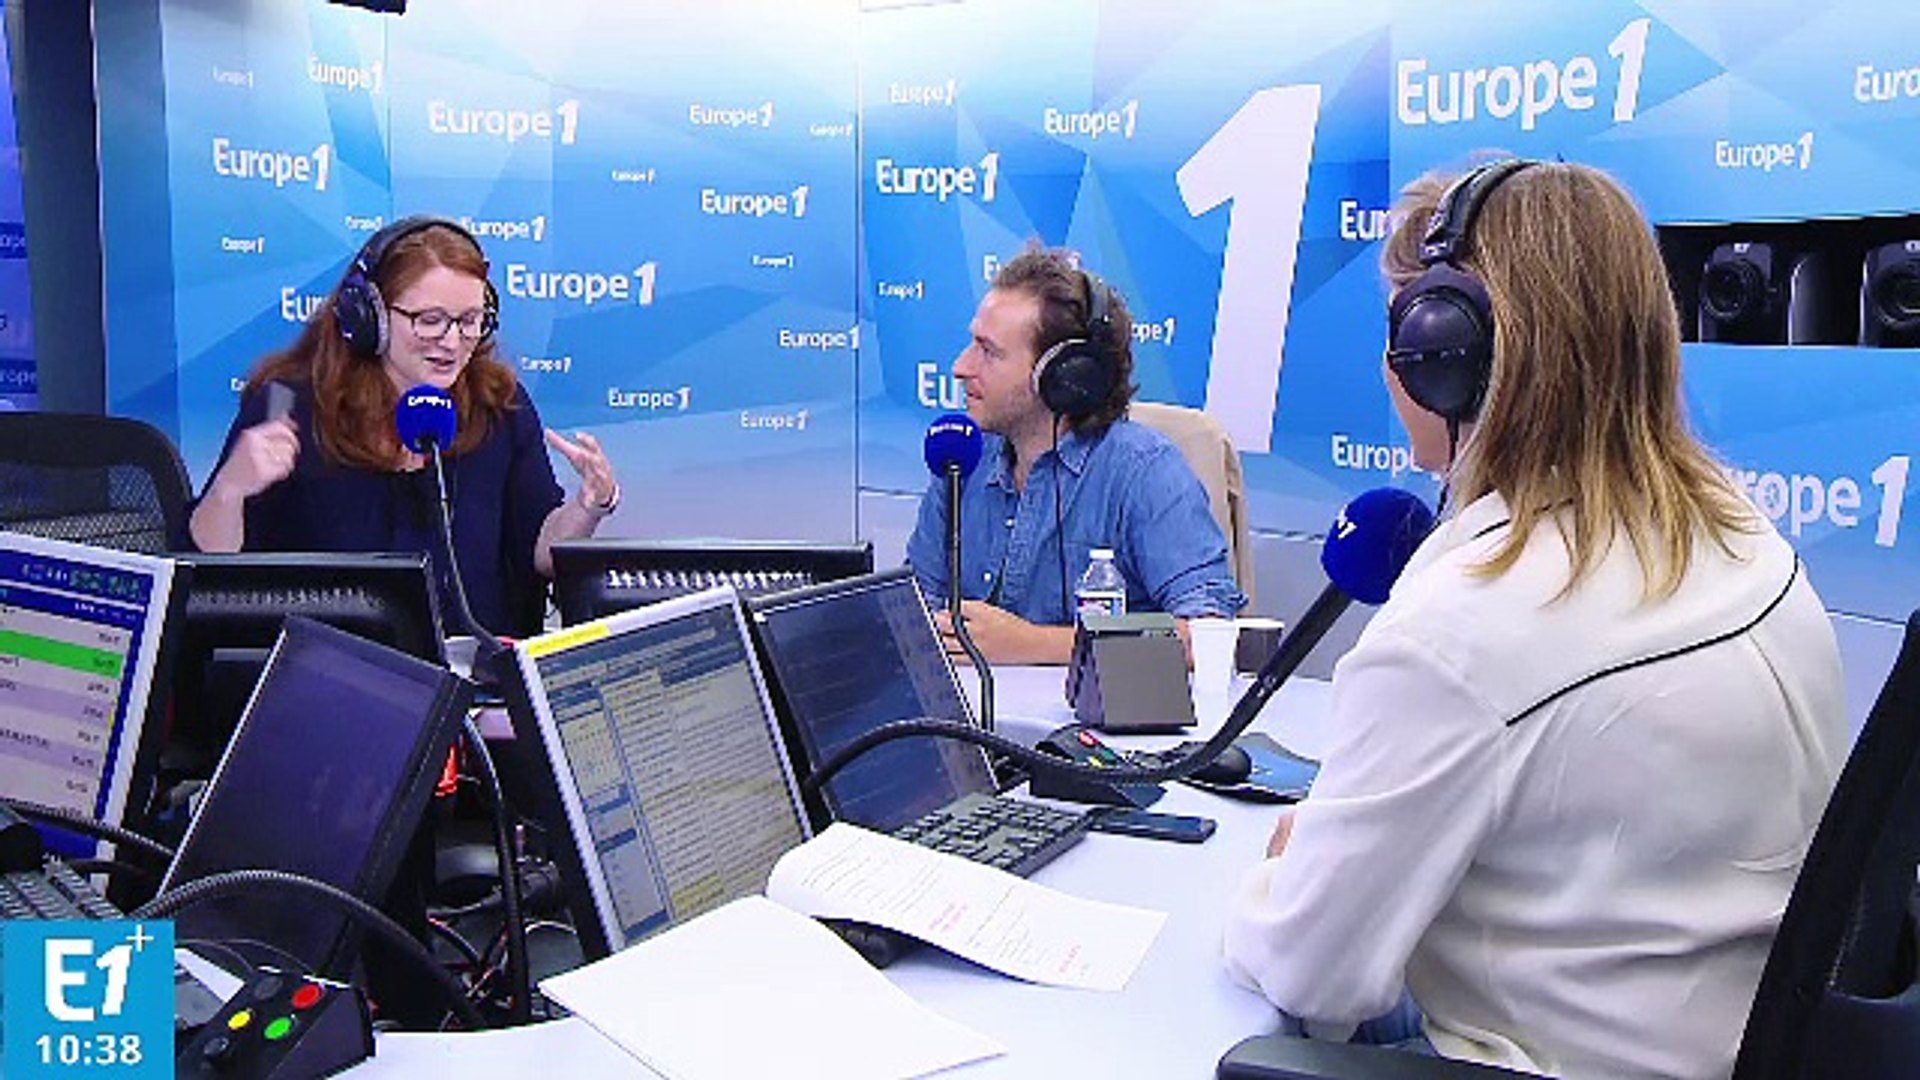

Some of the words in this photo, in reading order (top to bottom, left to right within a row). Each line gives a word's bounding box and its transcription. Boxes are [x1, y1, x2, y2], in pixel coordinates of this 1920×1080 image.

[1340, 200, 1398, 241] Eur
[281, 287, 327, 322] Eur
[1131, 317, 1177, 345] ope1
